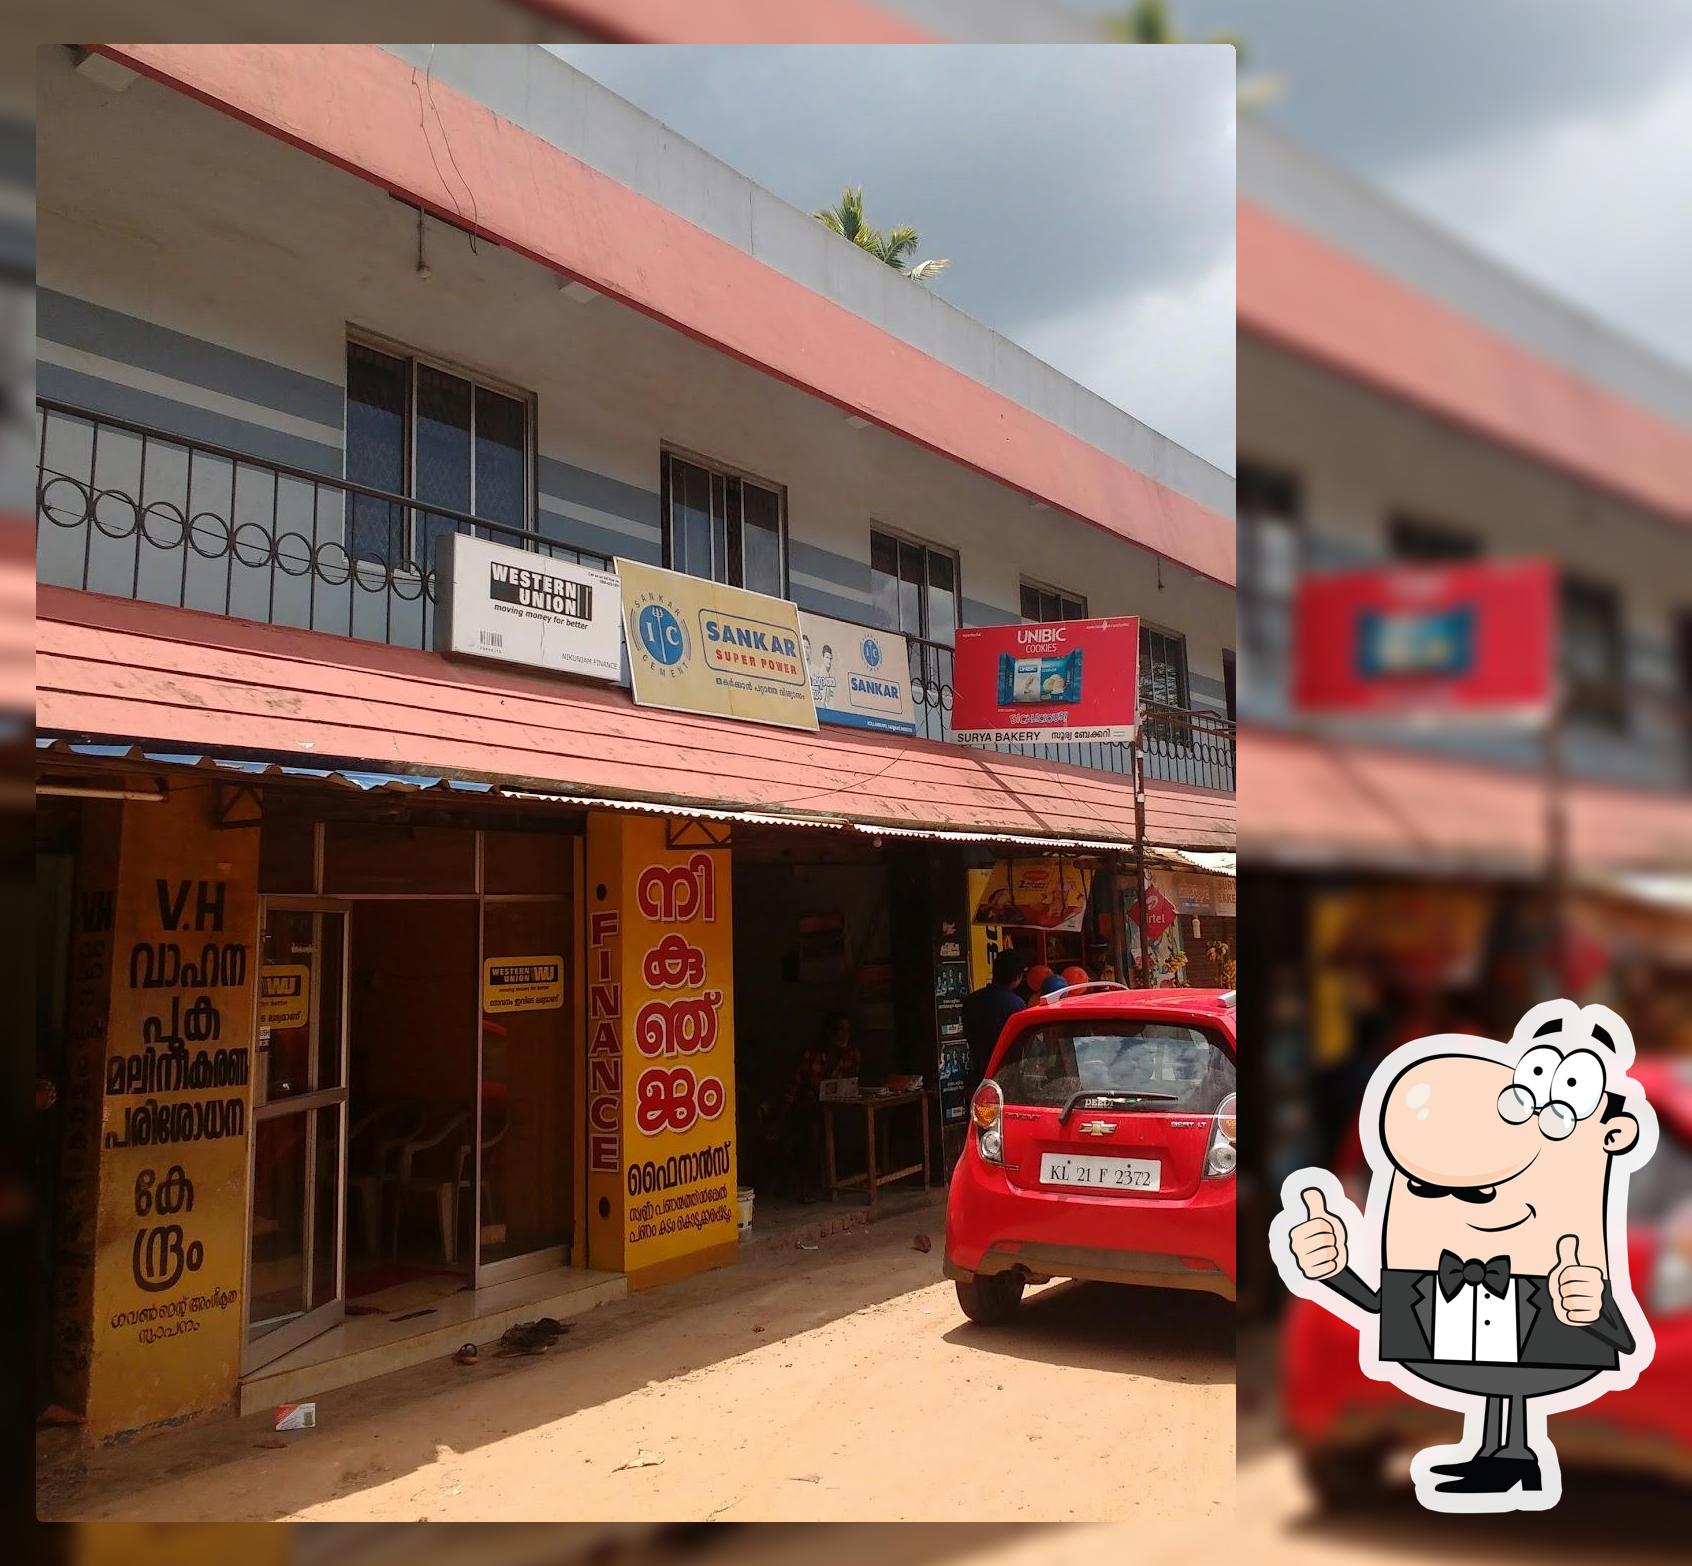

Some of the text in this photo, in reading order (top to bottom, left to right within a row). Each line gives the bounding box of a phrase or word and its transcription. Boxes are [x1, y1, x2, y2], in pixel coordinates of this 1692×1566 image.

[491, 563, 577, 600] WESTERN
[519, 587, 577, 617] UNION
[634, 592, 681, 617] SANKAR
[494, 603, 588, 631] moving money for better
[706, 620, 797, 658] SANKAR
[1017, 628, 1067, 644] UNIBIC
[1025, 643, 1057, 654] COOKIES
[642, 654, 688, 678] CEMENT
[715, 648, 797, 675] SUPER POWER
[850, 677, 899, 699] SANKAR
[957, 730, 1041, 743] SURYA BAKERY
[1074, 728, 1111, 739] ബേക്കറി
[130, 943, 247, 988] വാഹന
[491, 967, 530, 977] WESTERN
[503, 974, 530, 983] UNION
[589, 910, 623, 1174] FINANCE
[105, 1099, 244, 1149] പരിശോധന
[1050, 1165, 1151, 1187] KL 21 F 2372
[629, 1224, 656, 1243] പണം
[659, 1218, 676, 1235] കടം
